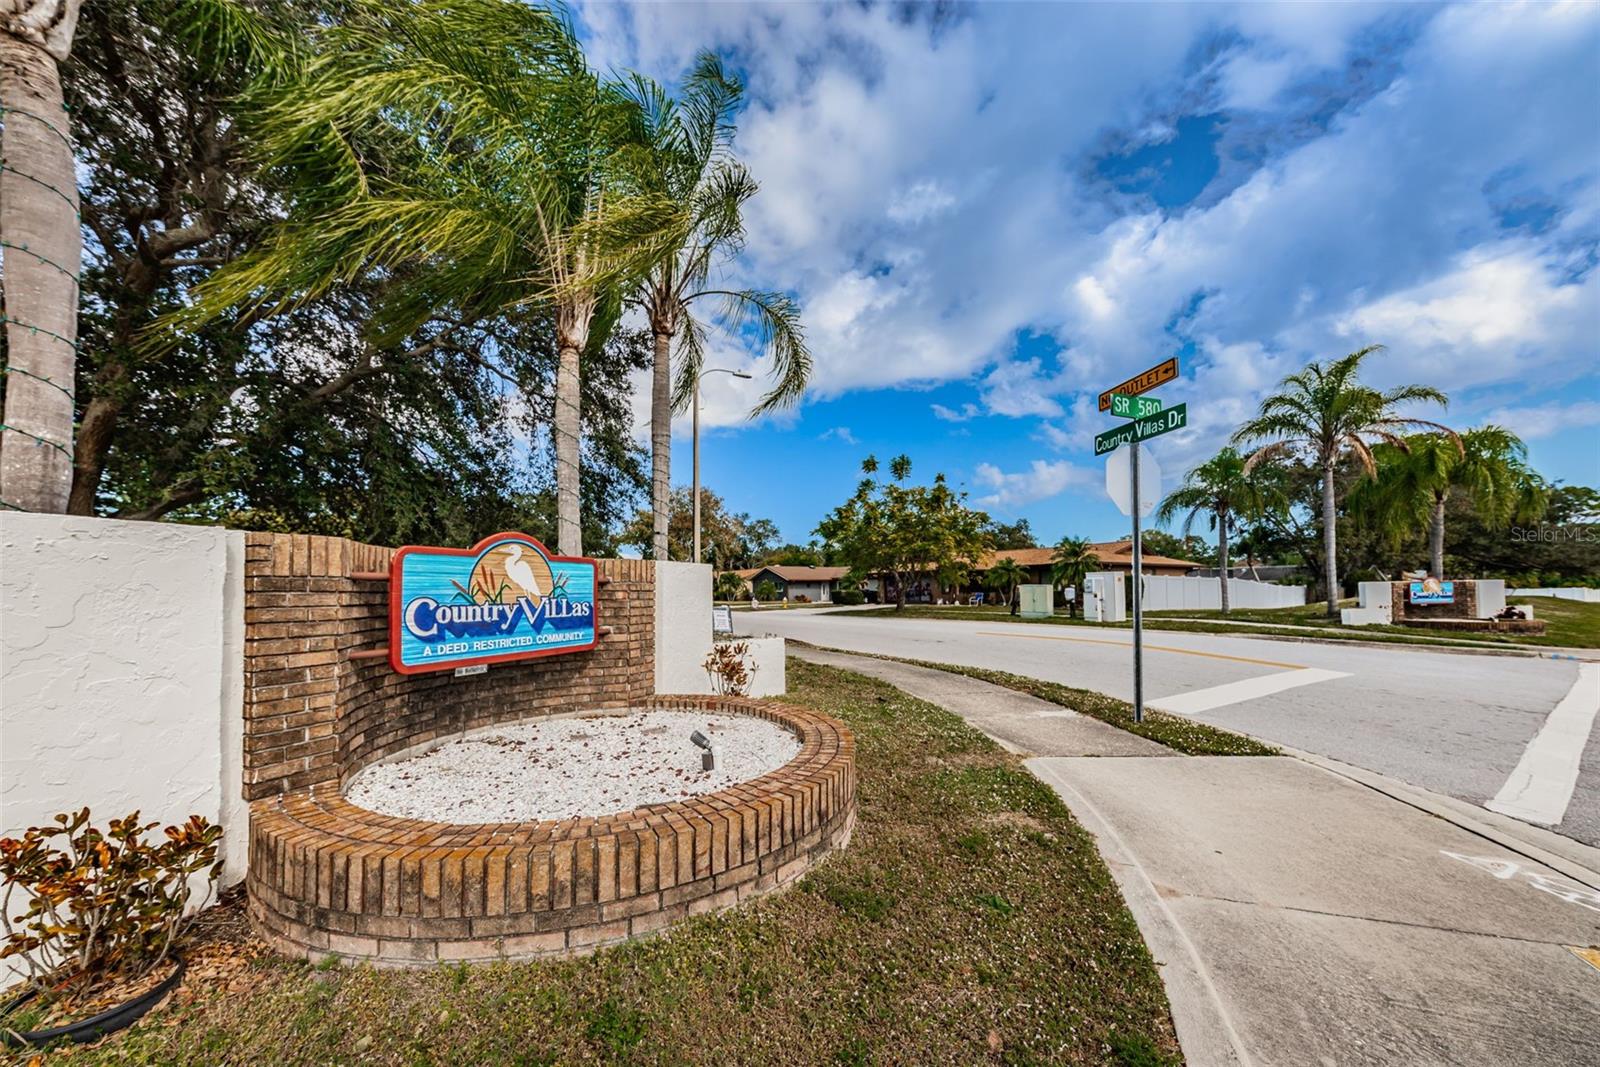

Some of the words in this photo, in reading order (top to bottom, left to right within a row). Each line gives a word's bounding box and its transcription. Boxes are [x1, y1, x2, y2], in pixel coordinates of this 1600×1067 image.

[1119, 369, 1161, 395] OUTLET
[1114, 396, 1130, 414] SR
[1138, 399, 1160, 416] 580
[1095, 430, 1133, 453] Country
[1135, 419, 1165, 438] Villas
[1168, 410, 1184, 429] Dr
[404, 596, 520, 637] Country
[423, 645, 433, 657] A
[437, 642, 469, 656] DEED
[473, 635, 532, 652] RESTRICTED
[536, 631, 585, 645] COMMUNITY
